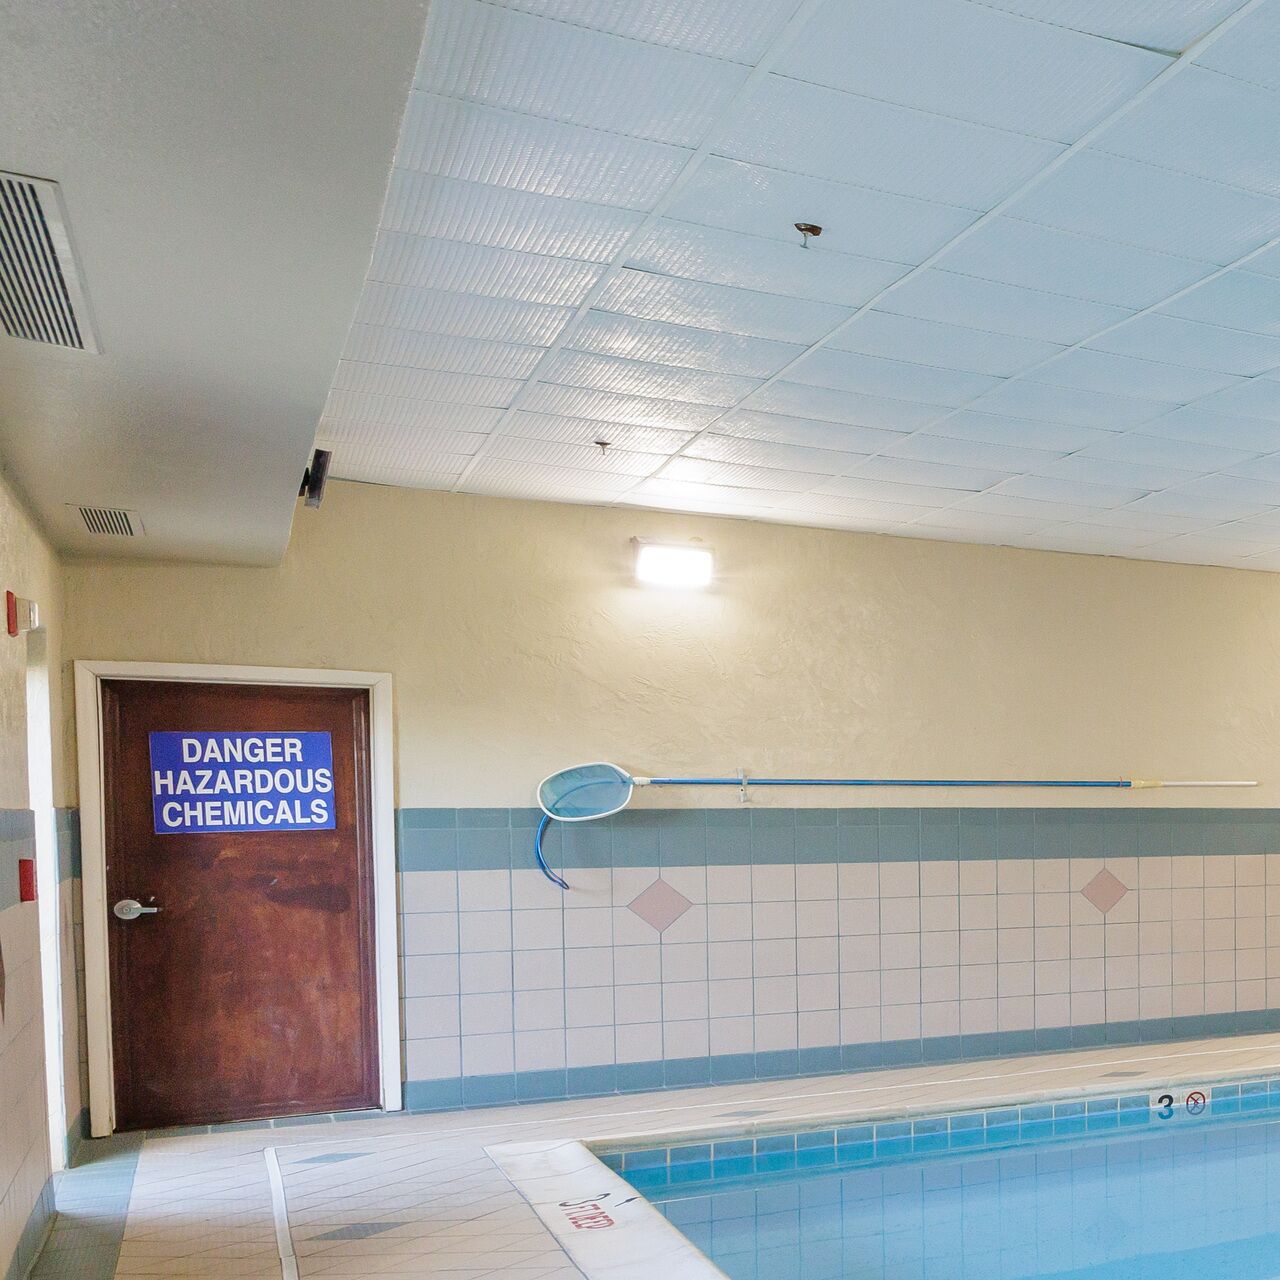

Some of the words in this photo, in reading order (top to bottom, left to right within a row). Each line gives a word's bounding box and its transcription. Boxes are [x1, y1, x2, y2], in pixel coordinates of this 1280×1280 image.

[182, 738, 303, 763] DANGER
[154, 768, 332, 795] HAZARDOUS
[162, 799, 328, 827] CHEMICALS
[1157, 1094, 1174, 1120] 3
[559, 1193, 611, 1207] 3
[569, 1212, 615, 1230] DEEP
